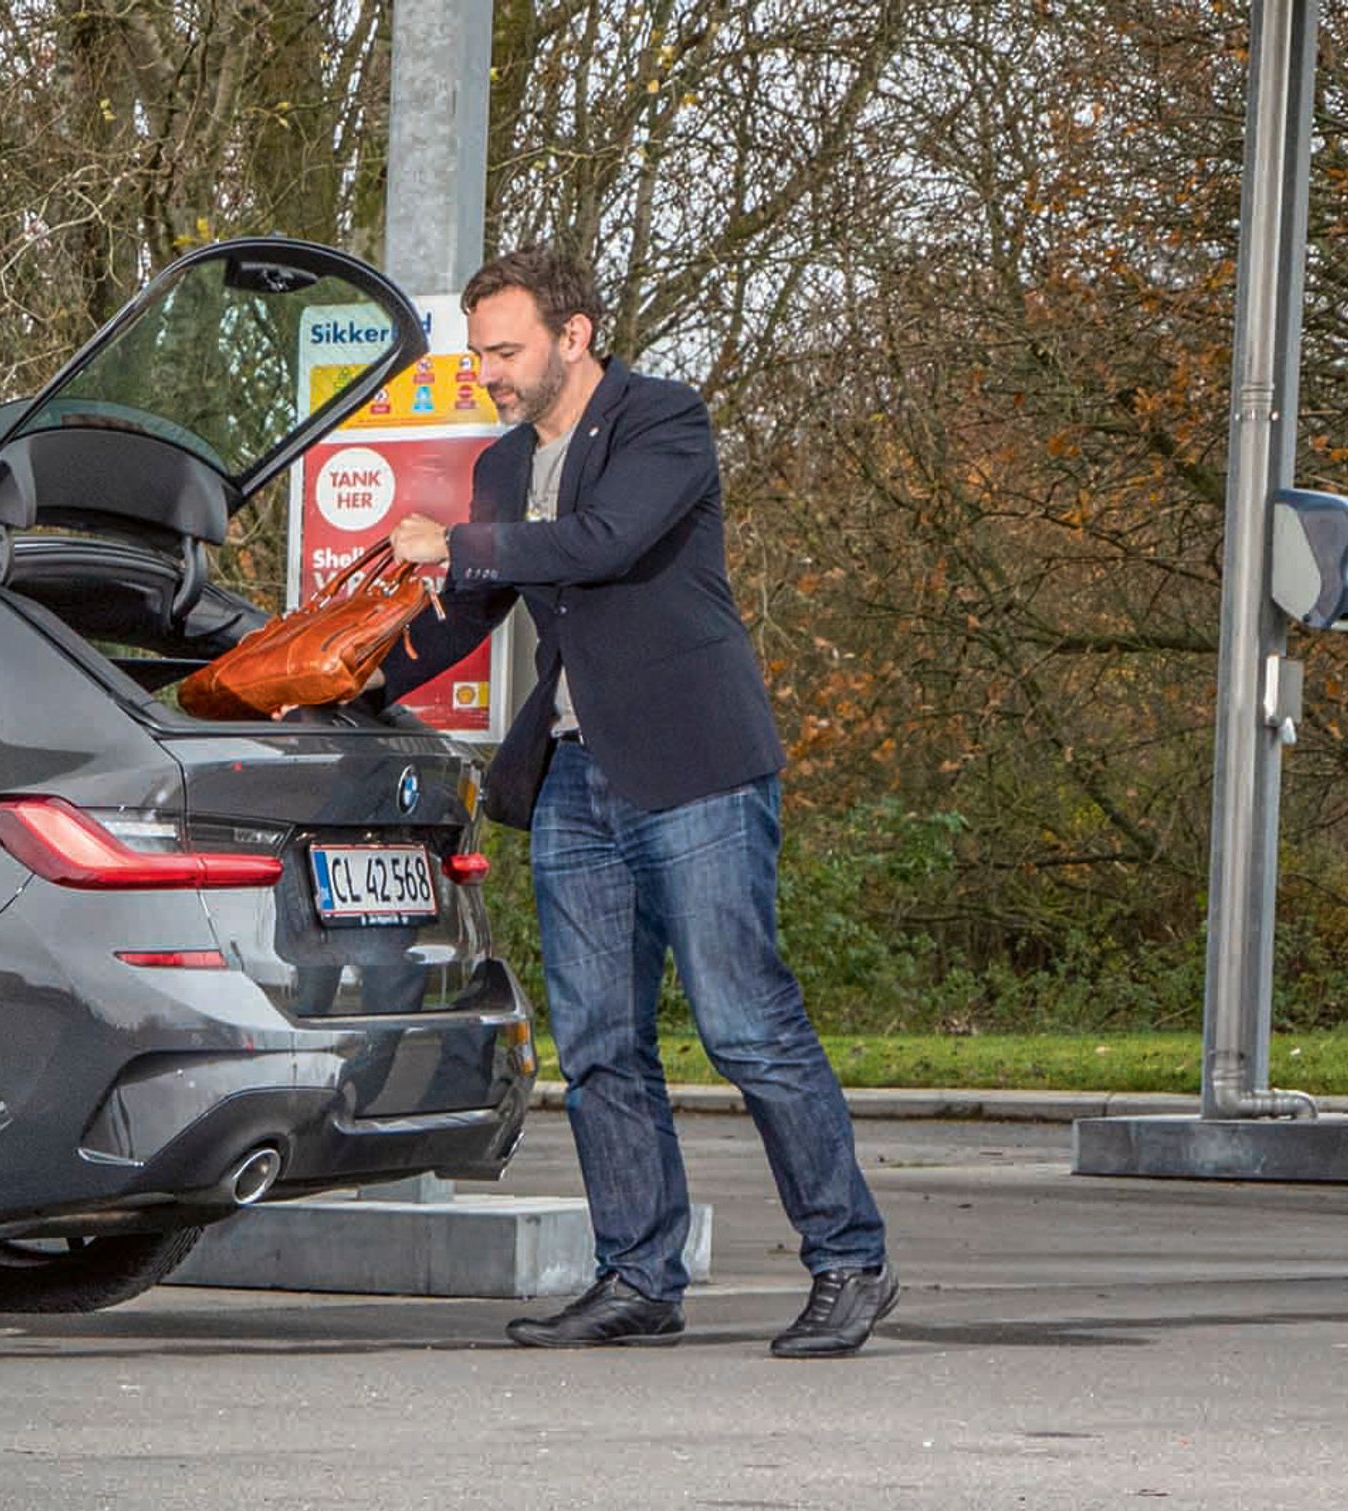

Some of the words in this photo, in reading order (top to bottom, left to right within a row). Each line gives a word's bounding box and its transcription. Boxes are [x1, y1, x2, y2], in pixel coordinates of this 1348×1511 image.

[311, 312, 432, 344] Sikkerd
[329, 471, 381, 487] TANK
[337, 493, 373, 509] HER
[332, 858, 361, 903] CL
